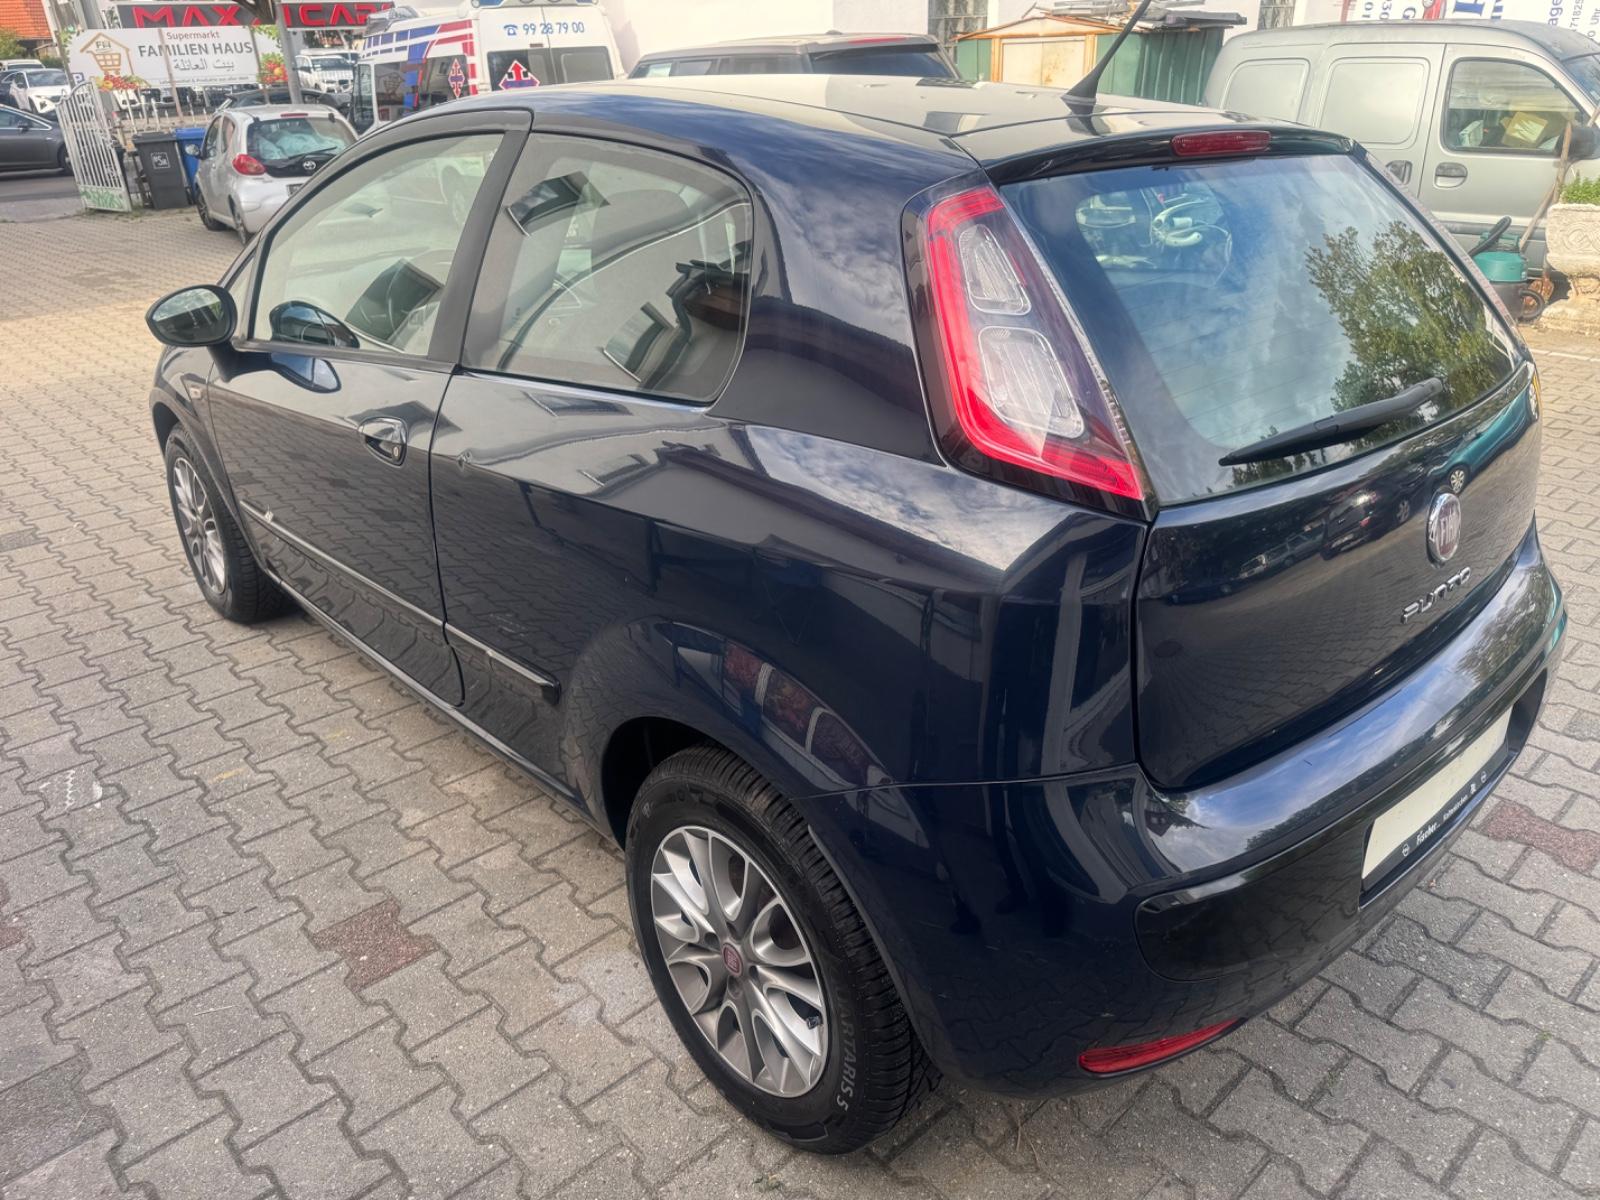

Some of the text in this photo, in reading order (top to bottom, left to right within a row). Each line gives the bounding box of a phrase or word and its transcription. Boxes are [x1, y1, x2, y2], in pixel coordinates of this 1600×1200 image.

[166, 30, 220, 41] Supermarkt
[522, 22, 536, 36] 99
[556, 21, 569, 35] 79
[571, 21, 585, 34] 00
[138, 40, 254, 58] FAMILIEN HAUS
[836, 1095, 850, 1112] 5
